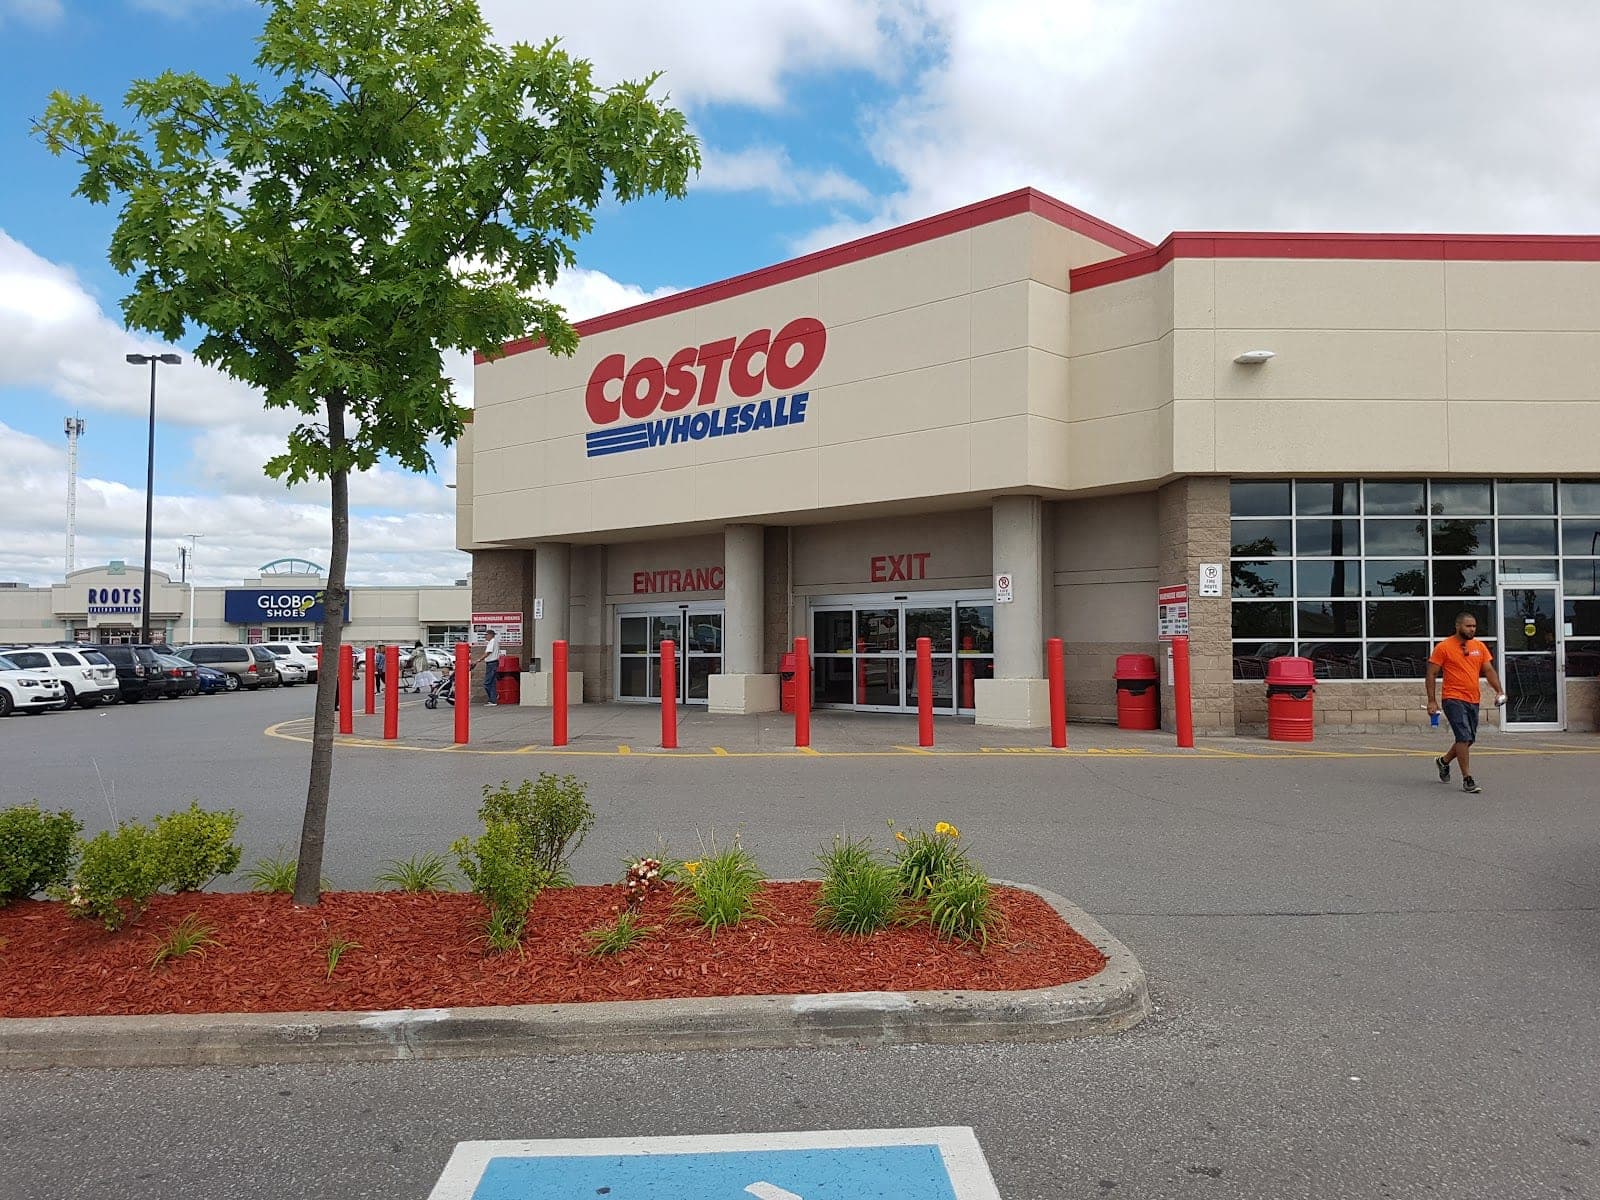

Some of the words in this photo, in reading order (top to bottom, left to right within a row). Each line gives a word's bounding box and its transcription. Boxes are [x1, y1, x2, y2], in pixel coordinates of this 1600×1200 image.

[585, 317, 827, 425] COSTCO
[646, 391, 810, 448] WHOLESALE
[633, 566, 725, 594] ENTRANC
[870, 552, 931, 583] EXIT
[88, 588, 142, 604] ROOTS
[257, 595, 316, 609] GLOBO
[266, 609, 306, 617] SHOES
